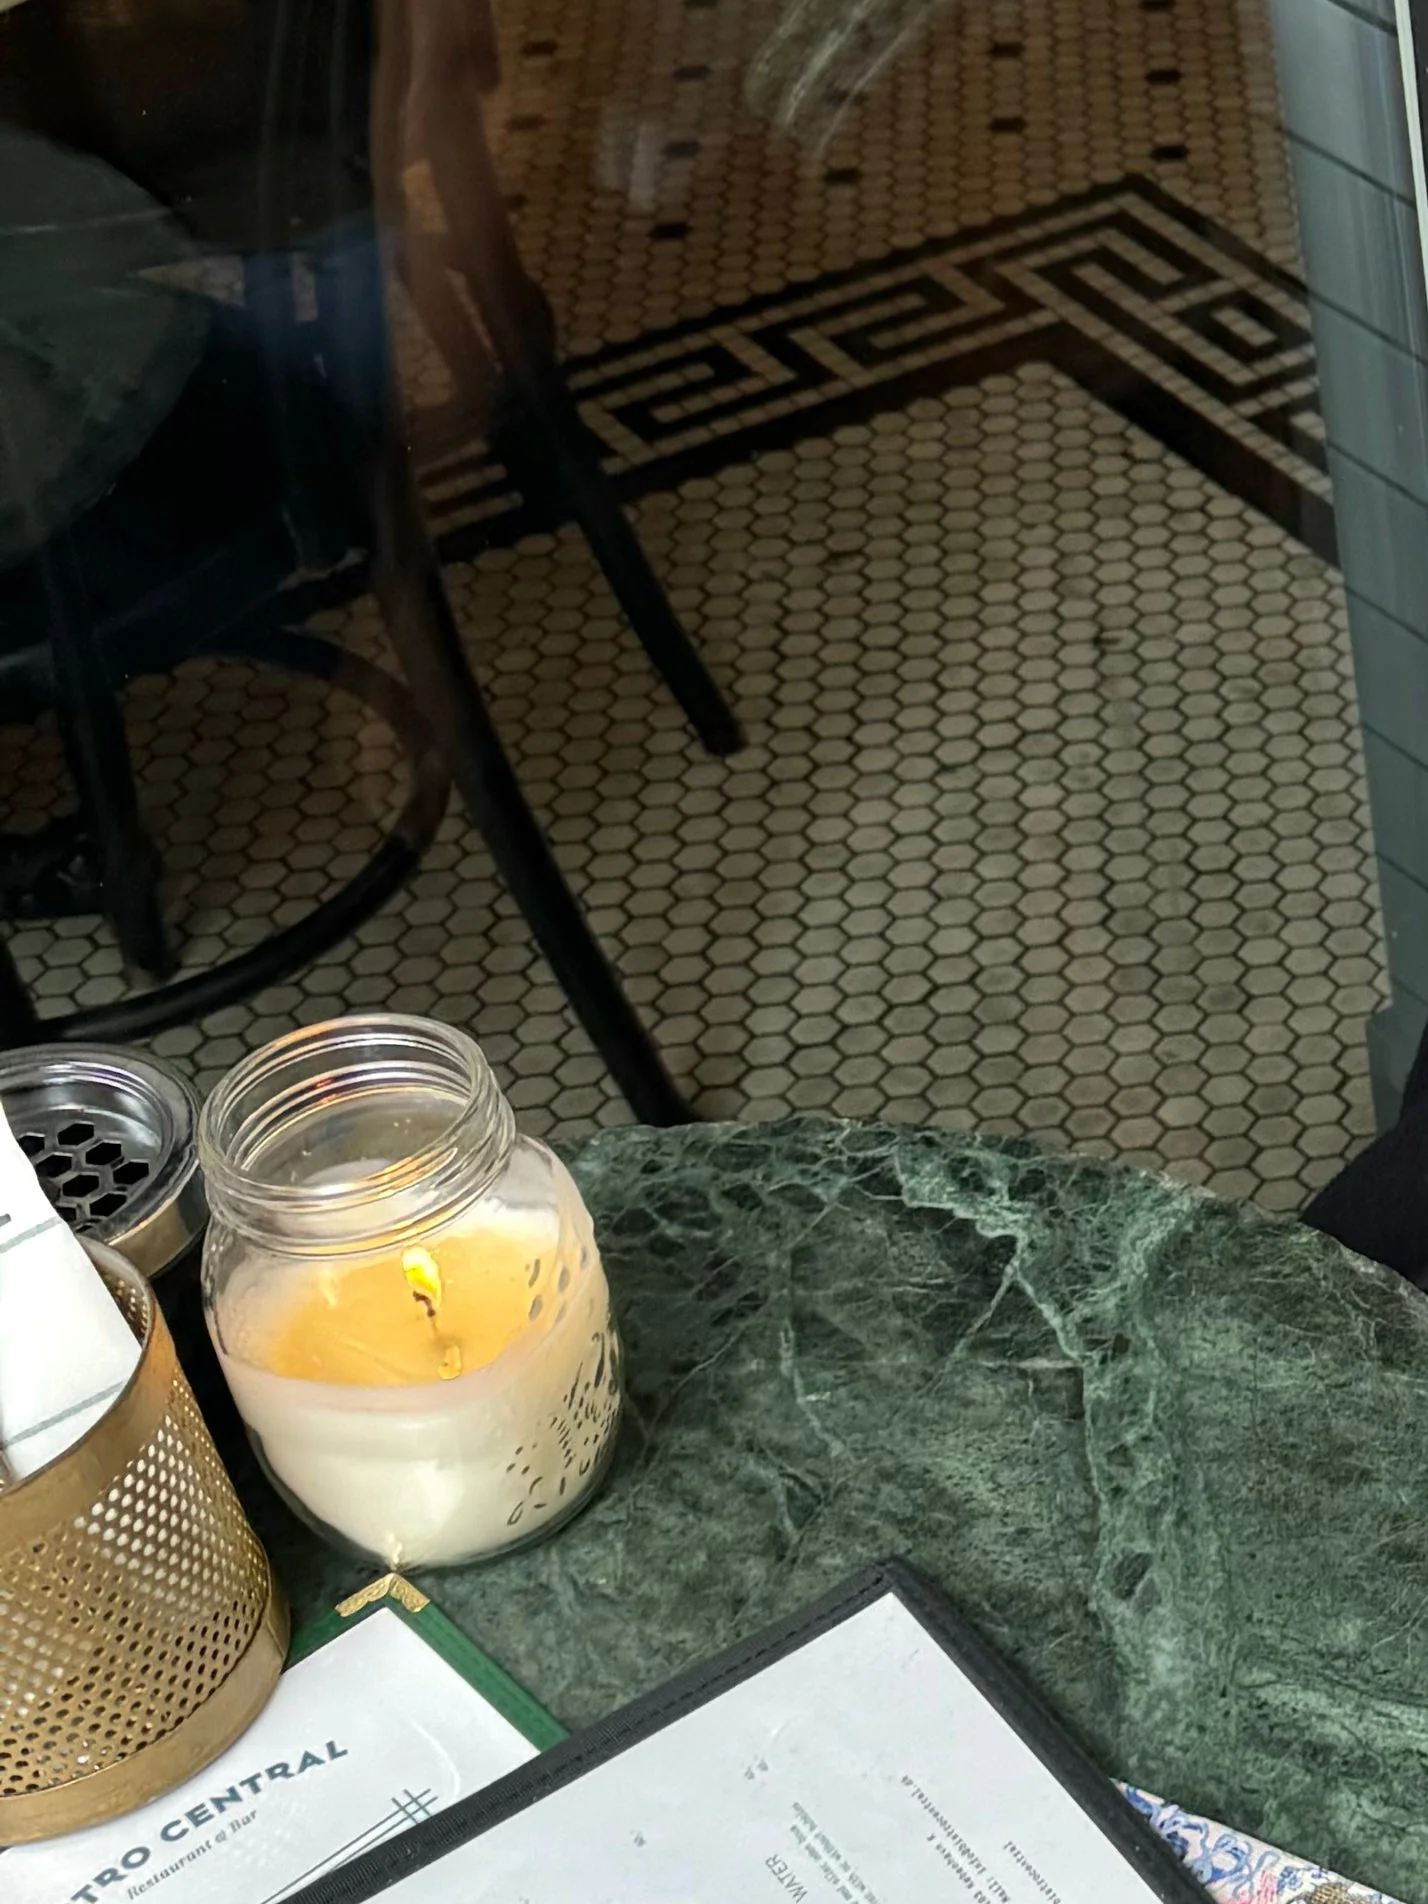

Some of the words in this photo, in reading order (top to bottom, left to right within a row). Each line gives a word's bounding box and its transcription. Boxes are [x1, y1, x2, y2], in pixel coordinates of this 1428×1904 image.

[160, 1740, 348, 1842] CENTRAL
[127, 1842, 212, 1900] Restaurant
[230, 1809, 258, 1833] Bar
[764, 1853, 808, 1904] WATER
